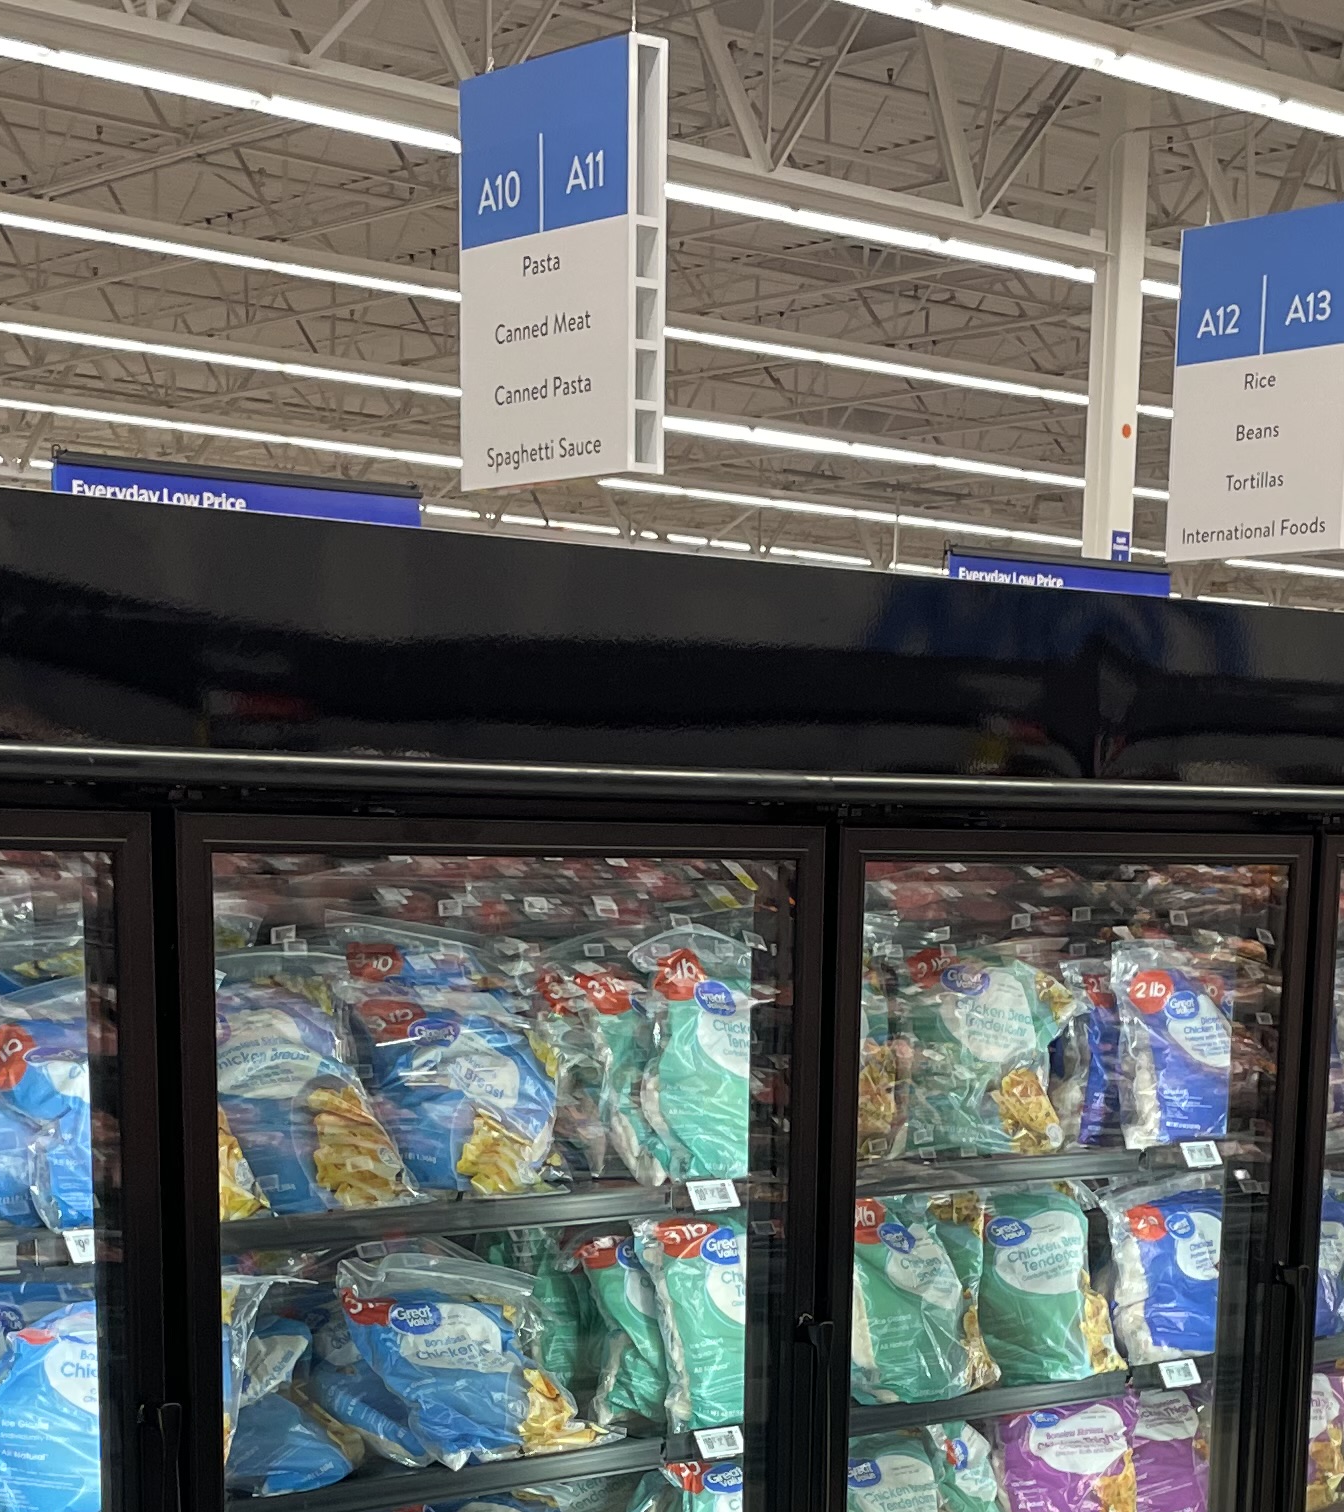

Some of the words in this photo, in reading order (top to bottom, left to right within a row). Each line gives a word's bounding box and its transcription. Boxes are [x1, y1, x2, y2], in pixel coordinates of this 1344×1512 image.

[478, 170, 522, 215] A10
[565, 149, 605, 195] A11
[522, 254, 561, 278] Pasta
[1197, 304, 1241, 339] A12
[1284, 289, 1332, 327] A13
[494, 316, 549, 346] Canned
[553, 309, 591, 335] Meat
[494, 379, 548, 406] Canned
[553, 374, 592, 398] Pasta
[1244, 372, 1276, 391] Rice
[1235, 423, 1280, 442] Beans
[486, 438, 555, 473] Spaghetti
[560, 436, 602, 460] Sauce
[1226, 471, 1284, 492] Tortillas
[71, 479, 161, 505] Everyday
[163, 488, 200, 508] Low
[202, 491, 247, 512] Price
[1181, 520, 1275, 545] International
[1280, 516, 1326, 536] Foods
[958, 566, 1012, 584] Everyday
[1012, 571, 1036, 586] Low
[1036, 573, 1065, 588] Price
[1135, 984, 1147, 999] 2
[1149, 981, 1167, 998] lb
[706, 1237, 739, 1252] Grea
[395, 1304, 433, 1321] Great
